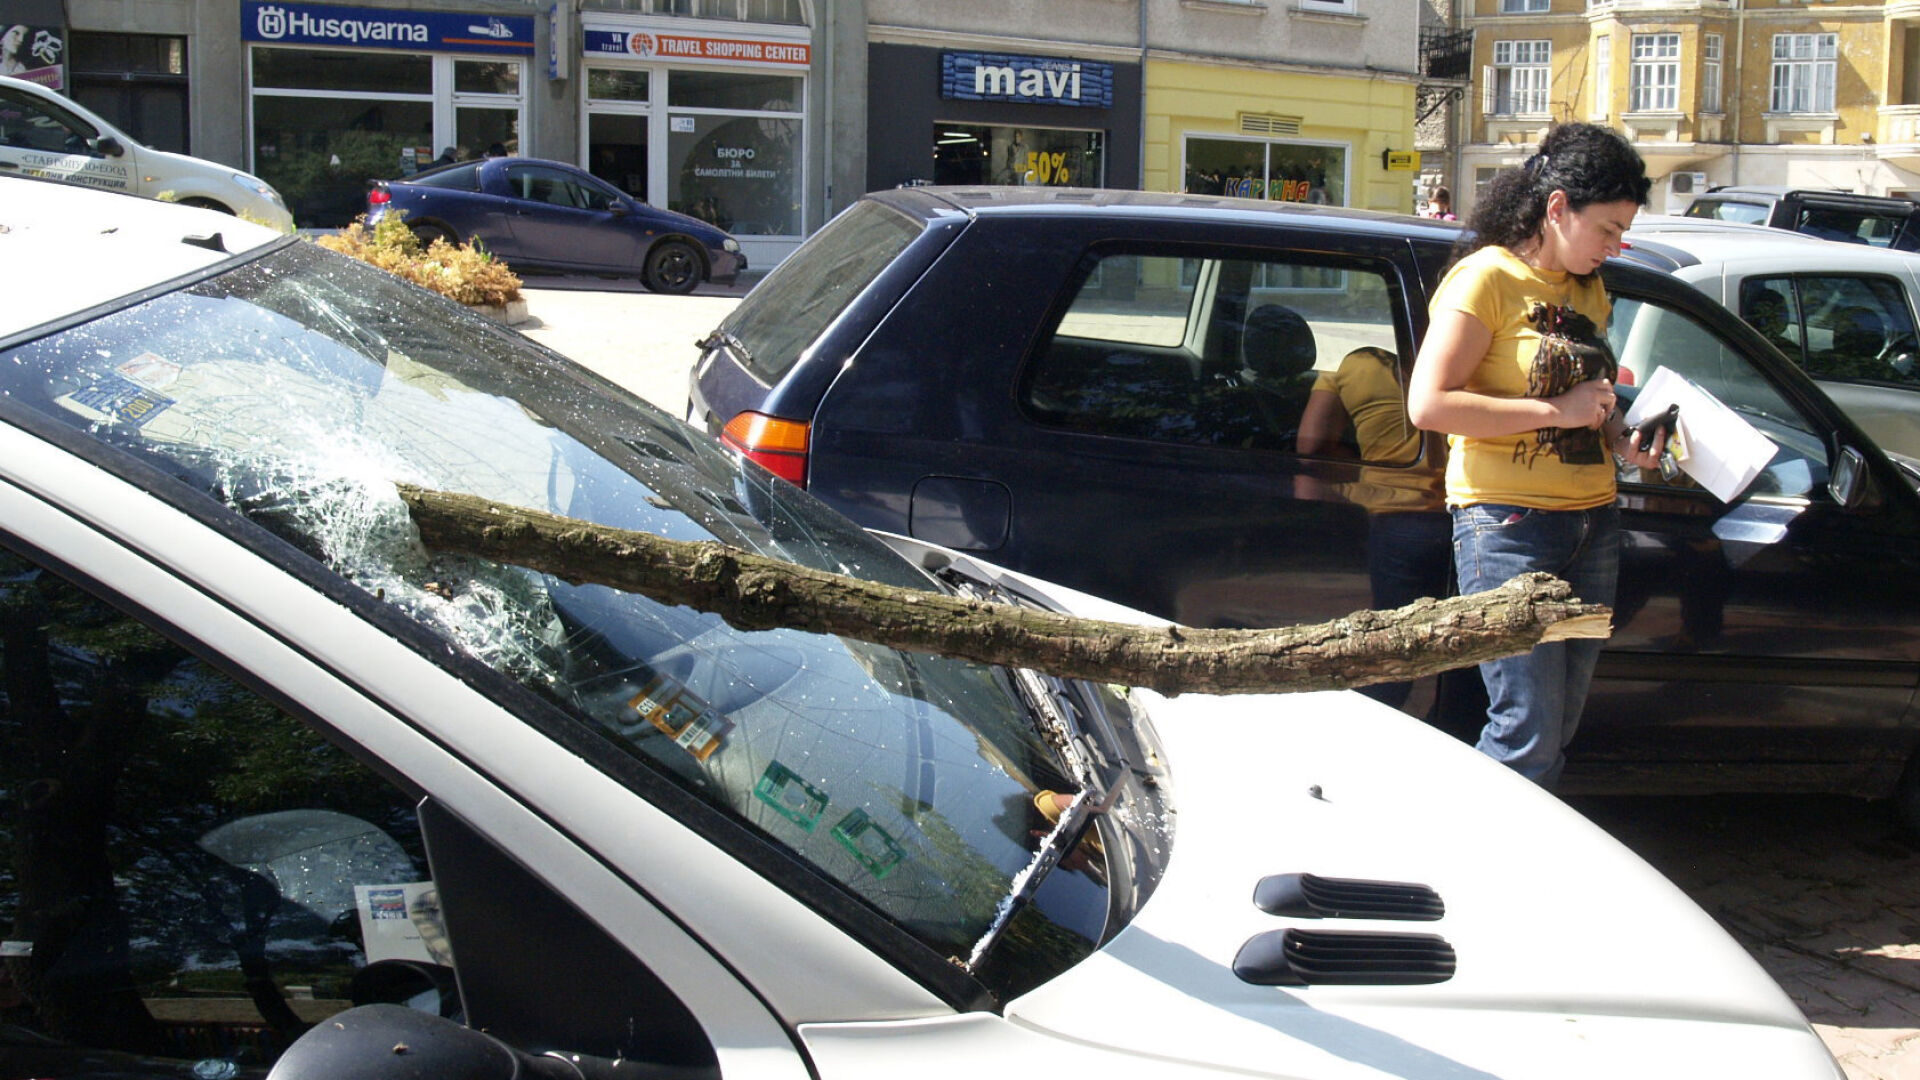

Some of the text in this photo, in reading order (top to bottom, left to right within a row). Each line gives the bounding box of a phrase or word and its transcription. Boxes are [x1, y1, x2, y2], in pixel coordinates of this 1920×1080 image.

[289, 12, 429, 43] Husqvarna
[611, 33, 622, 43] VA
[601, 43, 623, 52] travel
[661, 39, 806, 61] TRAVEL SHOPPING CENTER
[975, 64, 1081, 100] mavi
[717, 147, 756, 160] БЮРО
[731, 160, 742, 169] ЗА
[694, 167, 776, 179] САМОЛЕТНИ БИЛЕТИ
[1224, 177, 1311, 203] КАРИНА
